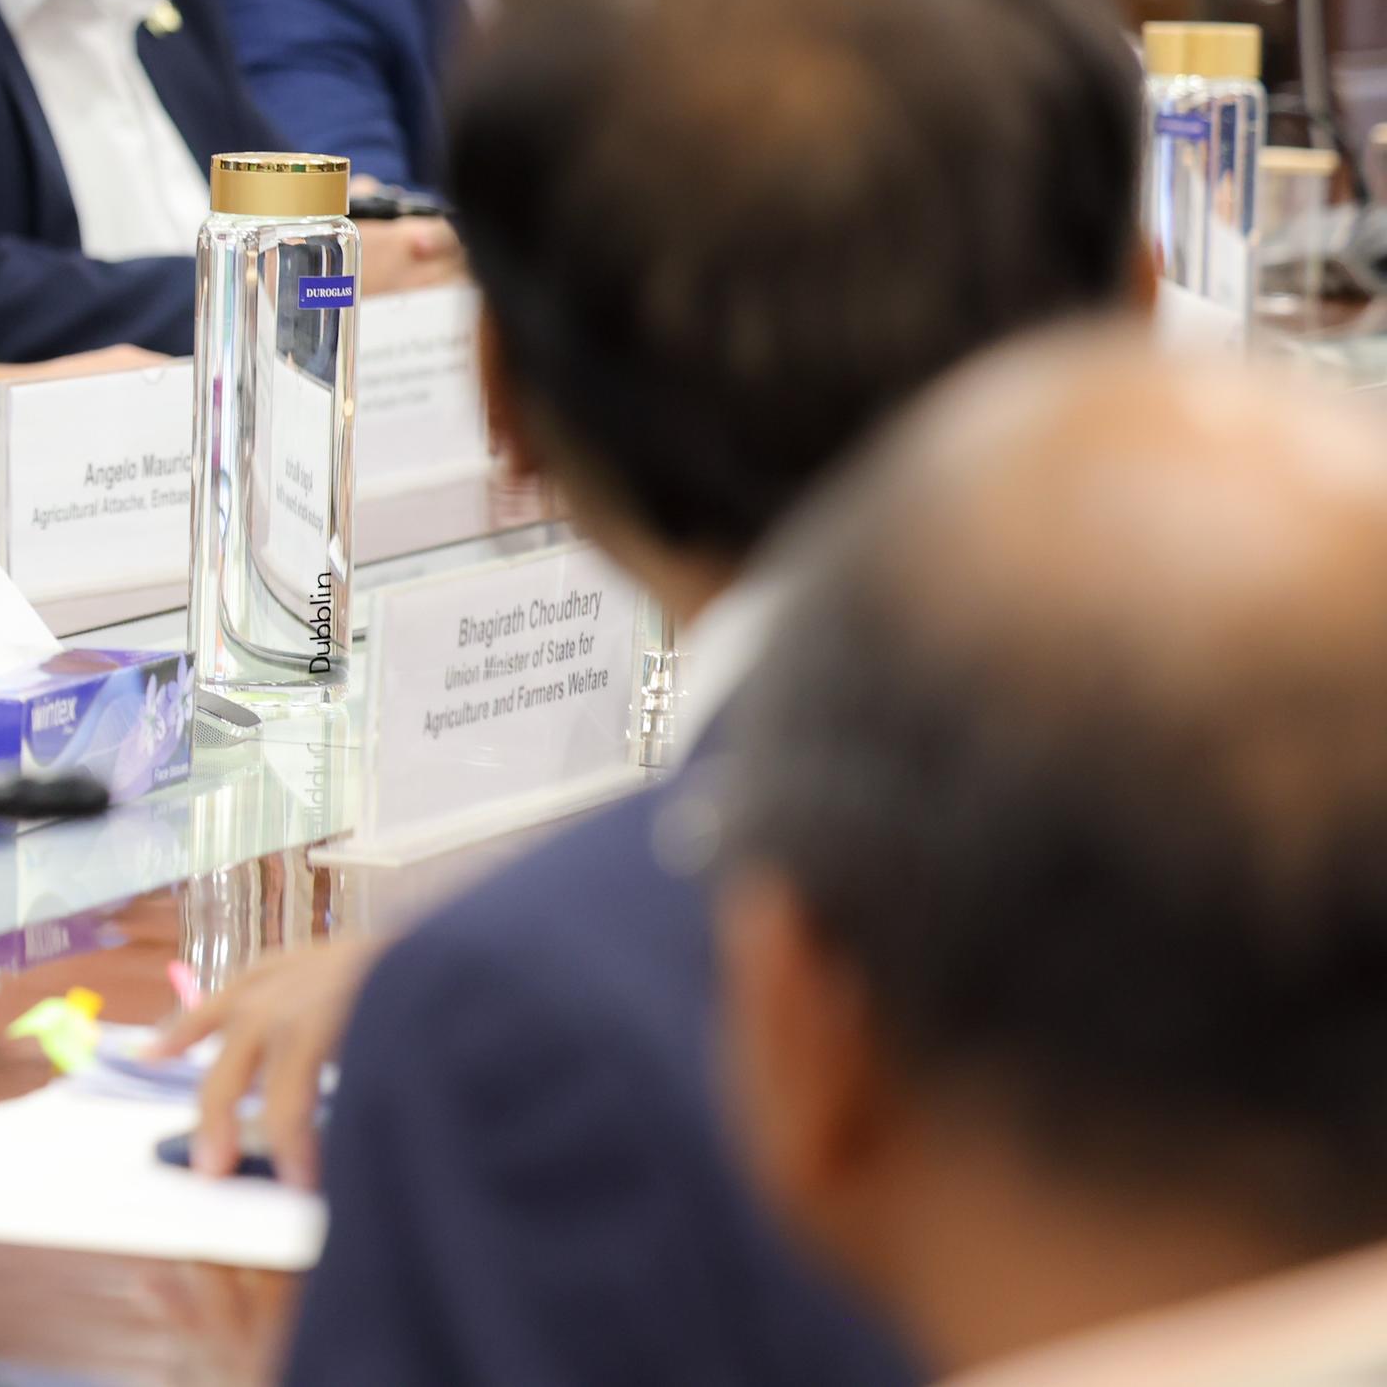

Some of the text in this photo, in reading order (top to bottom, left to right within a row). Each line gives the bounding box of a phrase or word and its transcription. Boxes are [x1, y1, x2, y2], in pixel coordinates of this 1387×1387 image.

[306, 286, 353, 298] DUROGLASS
[83, 452, 191, 489] Angelo Mauric
[32, 499, 98, 530] Agricultural
[151, 488, 190, 509] Embas
[309, 571, 332, 674] Dubblin
[458, 590, 603, 648] Bhagirath Choudhary
[445, 632, 595, 691] Union Minister of State for
[423, 667, 609, 740] Agriculture and Farmers Welfare
